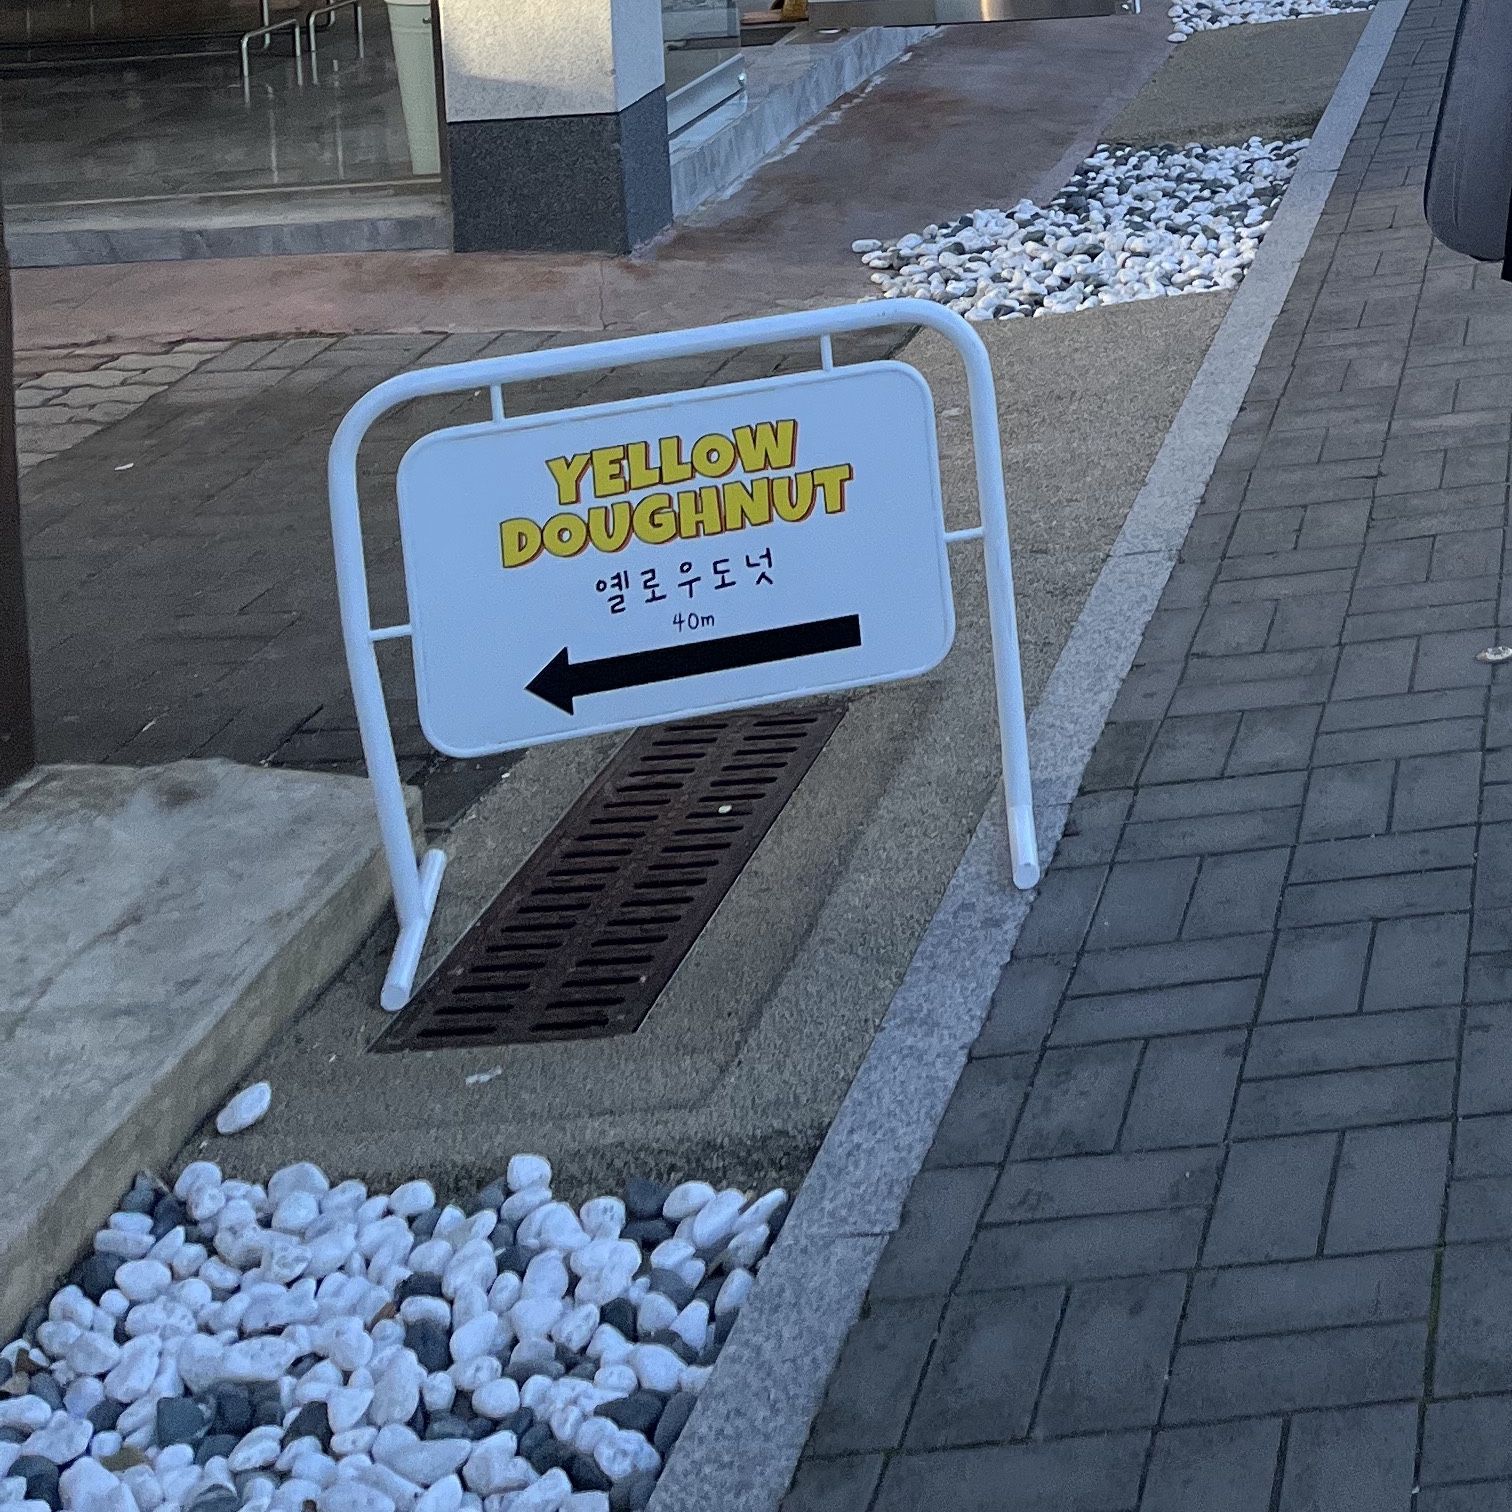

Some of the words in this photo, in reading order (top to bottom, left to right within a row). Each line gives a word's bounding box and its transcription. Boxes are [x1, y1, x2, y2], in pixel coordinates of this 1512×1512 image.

[546, 419, 798, 505] YELLOW
[499, 464, 853, 569] DOUGHNUT
[595, 547, 774, 615] 옐로우도넛
[673, 612, 716, 633] 40m
